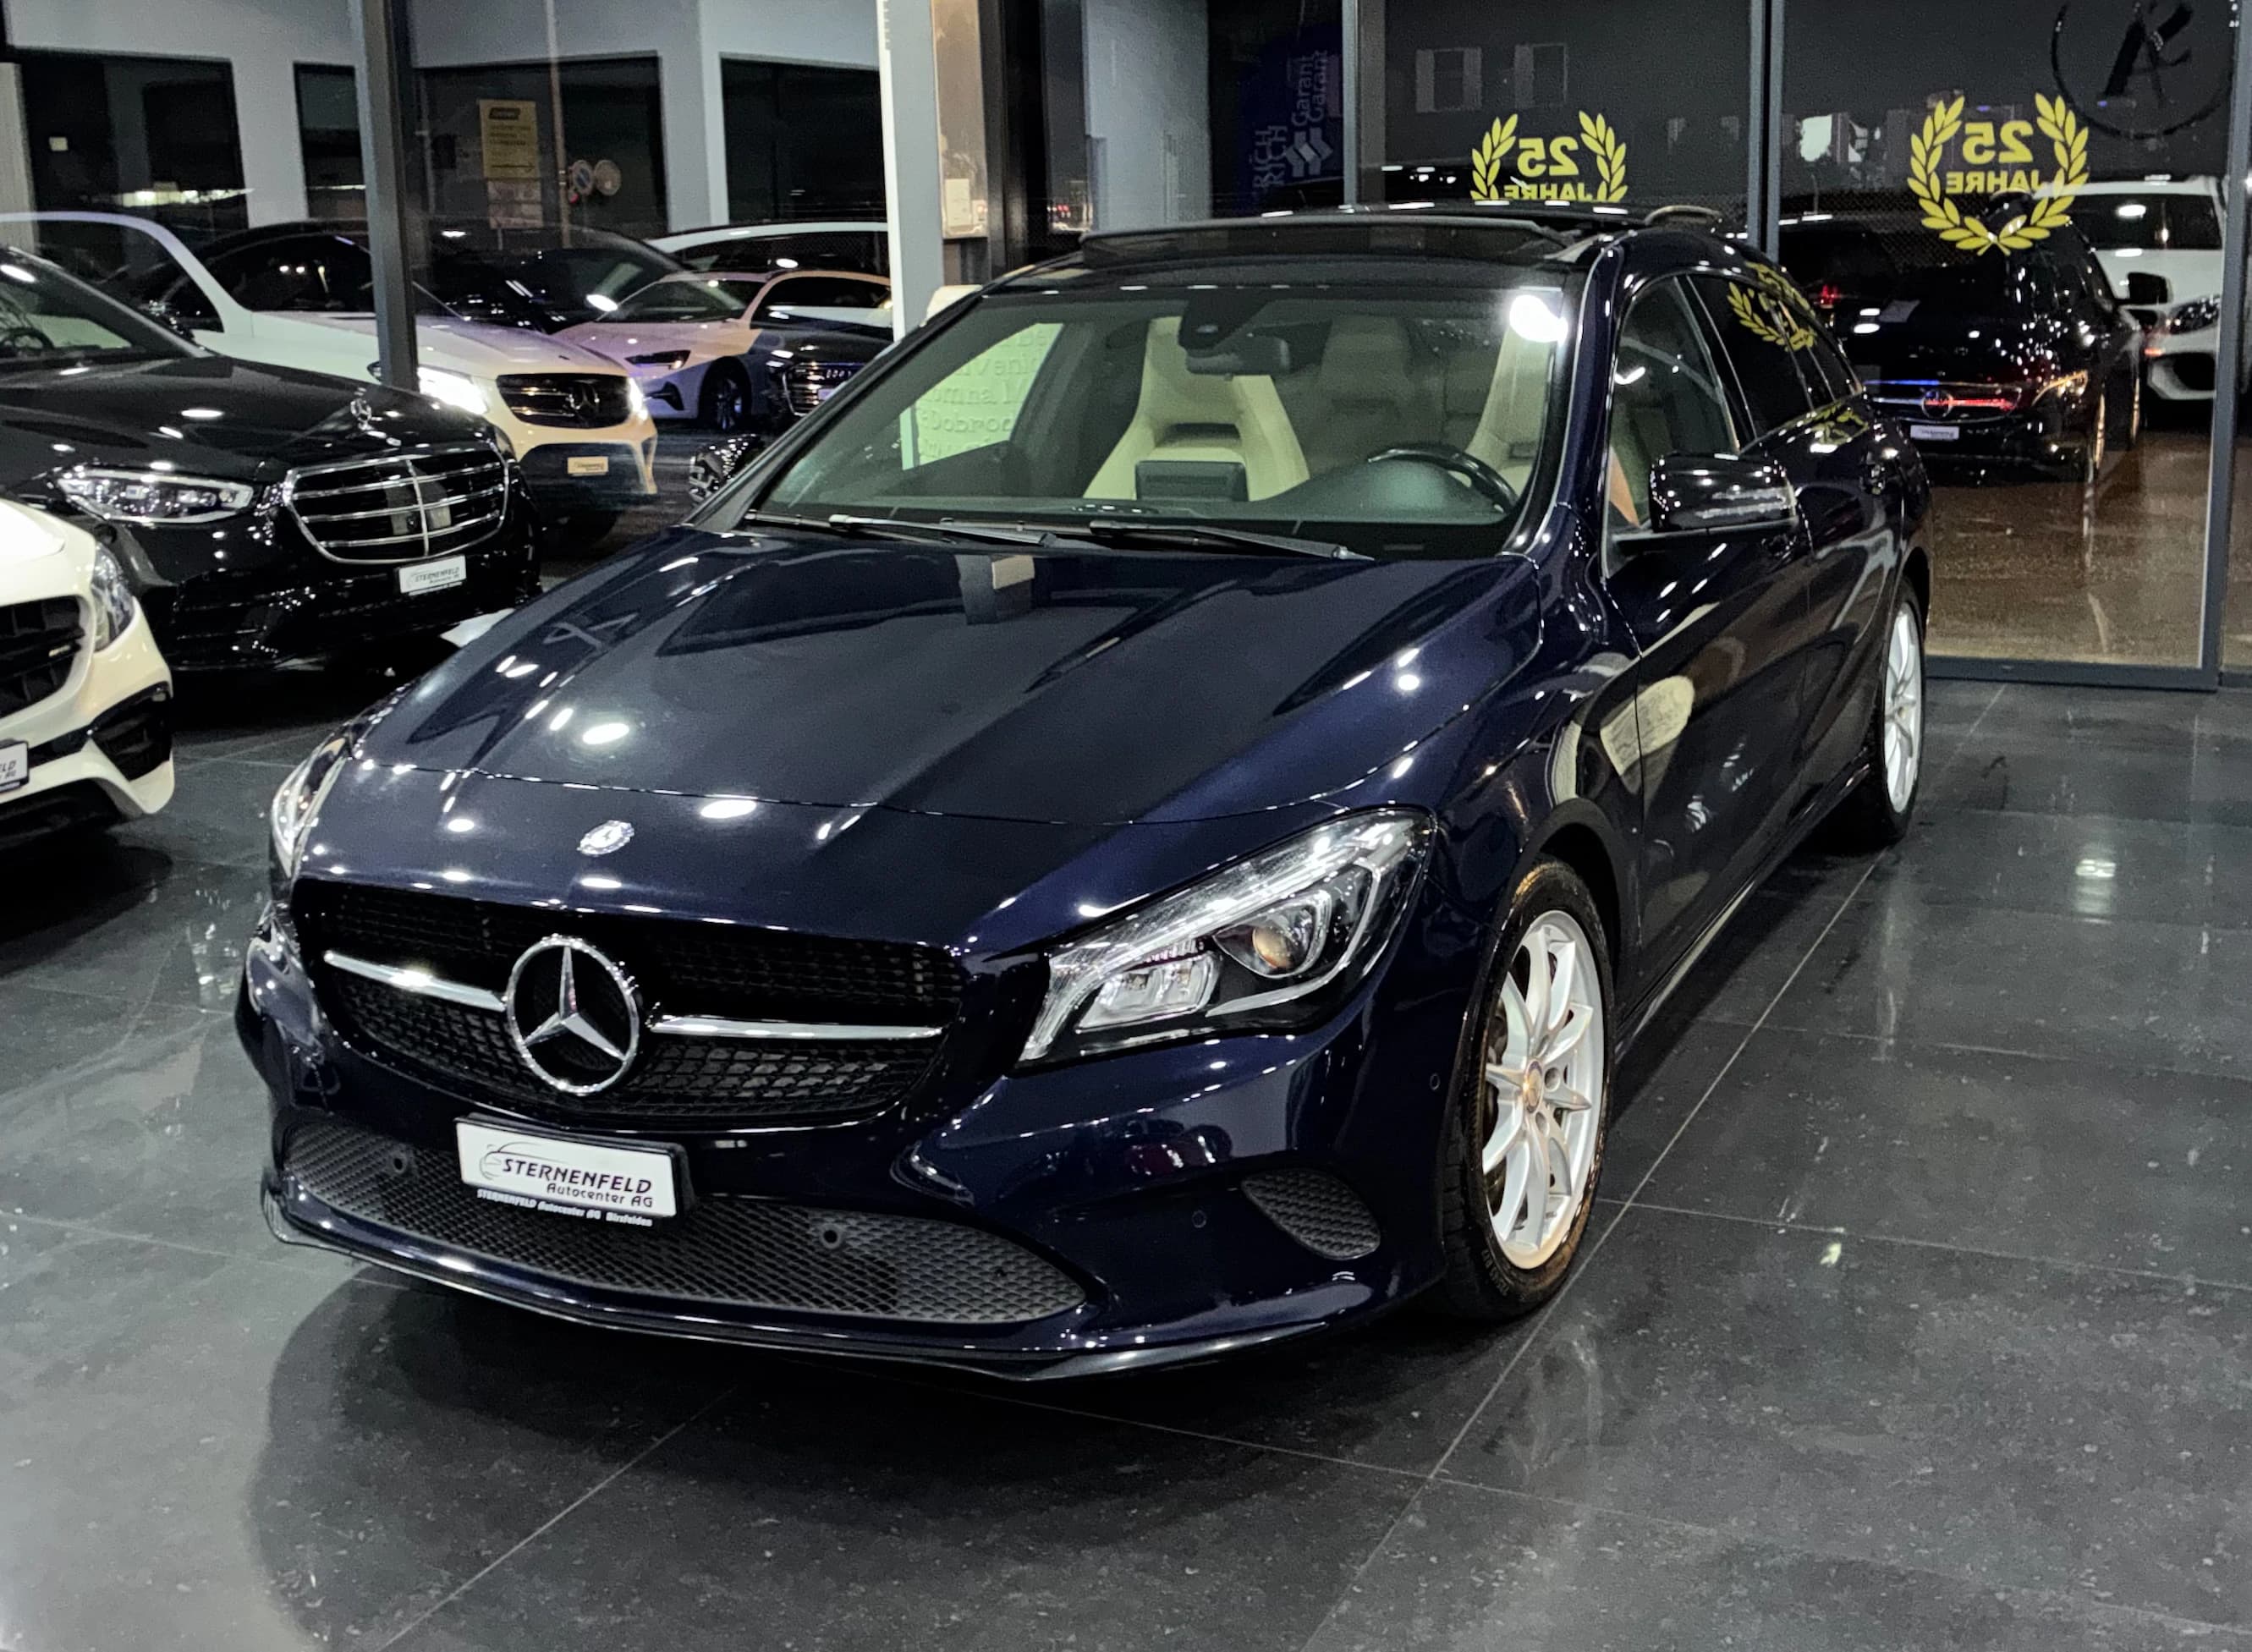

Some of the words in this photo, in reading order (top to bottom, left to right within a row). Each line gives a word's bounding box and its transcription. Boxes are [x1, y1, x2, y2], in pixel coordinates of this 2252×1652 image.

[503, 1158, 652, 1194] STERNENFELD
[547, 1183, 626, 1205] Autocenter
[630, 1195, 653, 1208] AG
